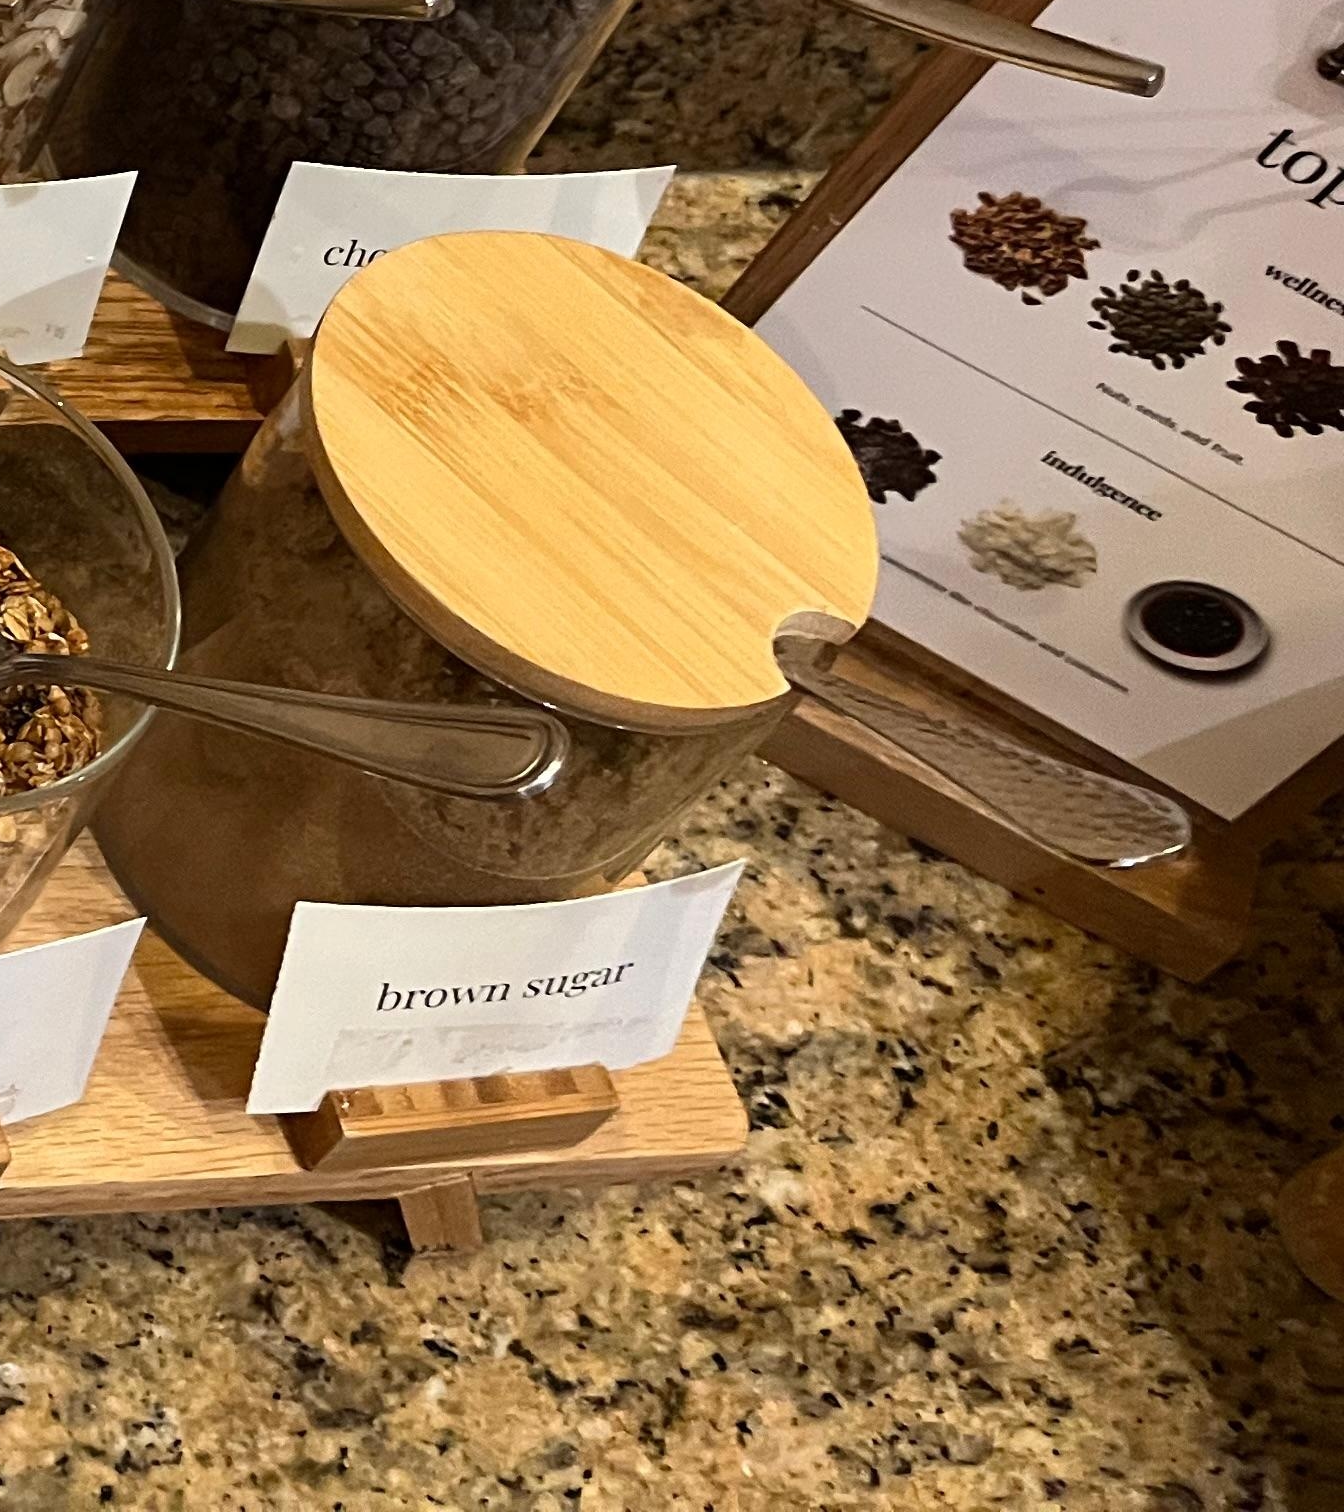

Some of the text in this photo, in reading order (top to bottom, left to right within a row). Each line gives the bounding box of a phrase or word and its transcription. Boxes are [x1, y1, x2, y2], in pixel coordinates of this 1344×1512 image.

[1265, 265, 1344, 317] wellne
[1040, 450, 1164, 522] indulgence
[376, 961, 635, 1012] brown sugar
